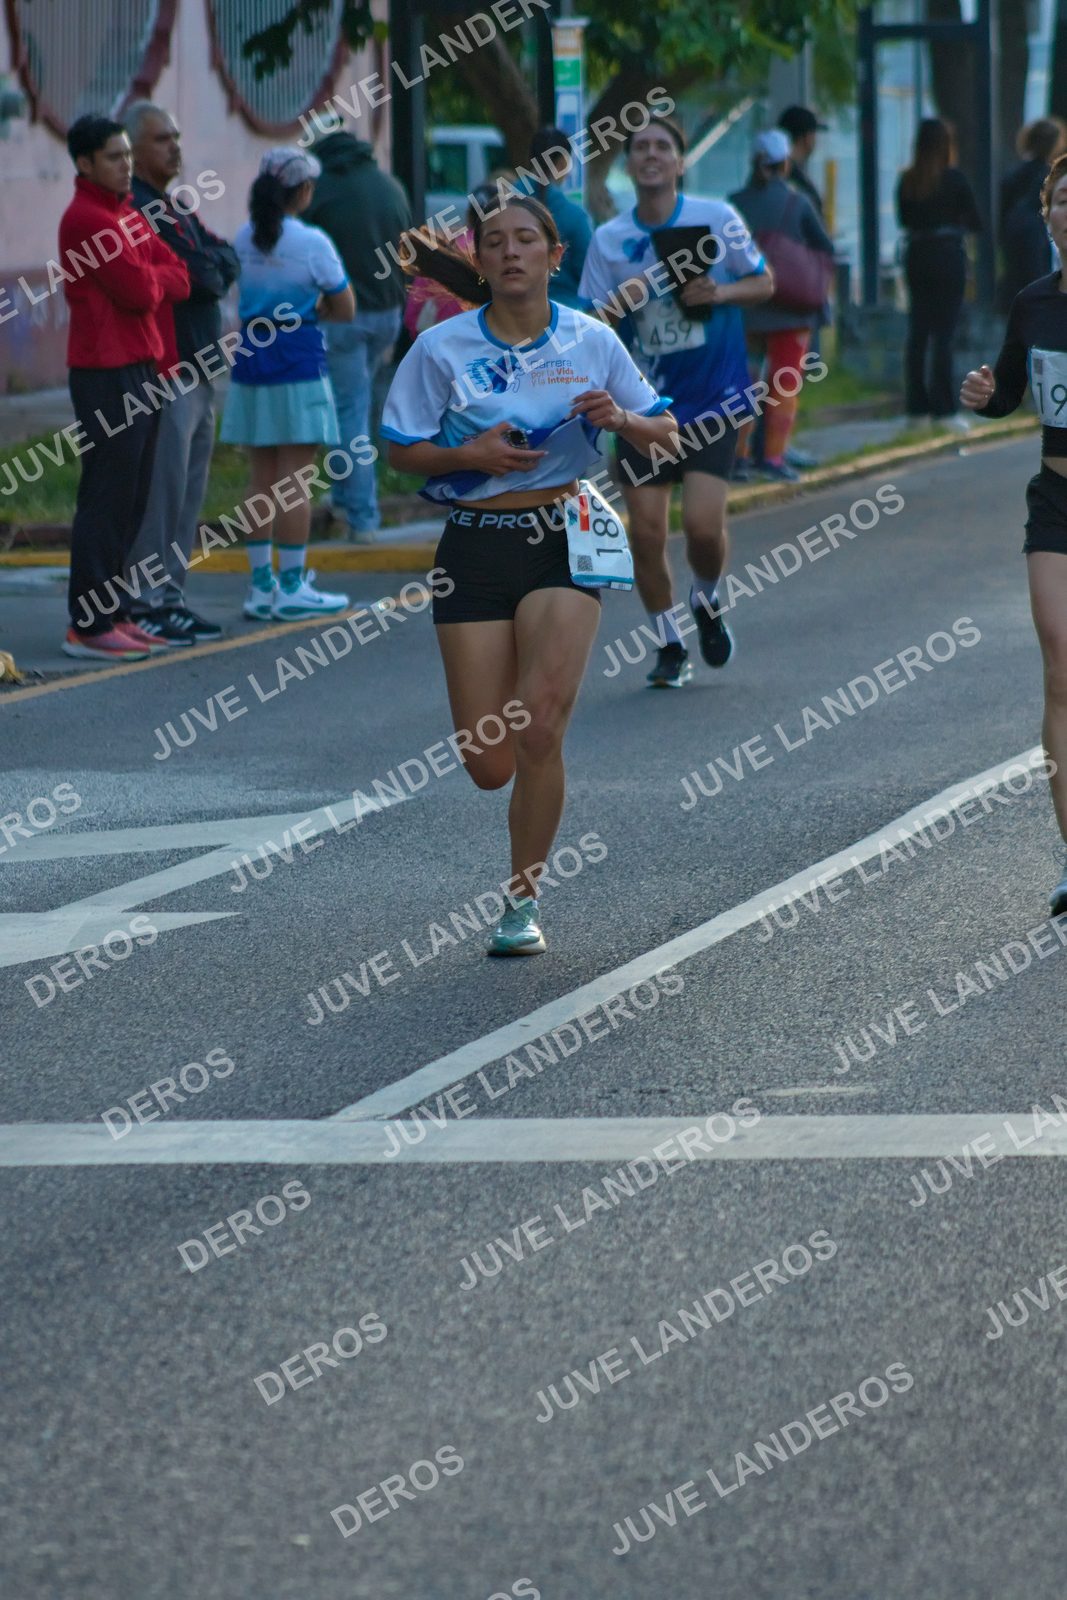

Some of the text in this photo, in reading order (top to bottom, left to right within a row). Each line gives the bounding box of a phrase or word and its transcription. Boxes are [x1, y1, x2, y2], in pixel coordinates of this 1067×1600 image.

[649, 320, 693, 347] 459
[556, 367, 574, 376] Vida
[547, 376, 589, 385] Integridad
[478, 512, 540, 530] PRO
